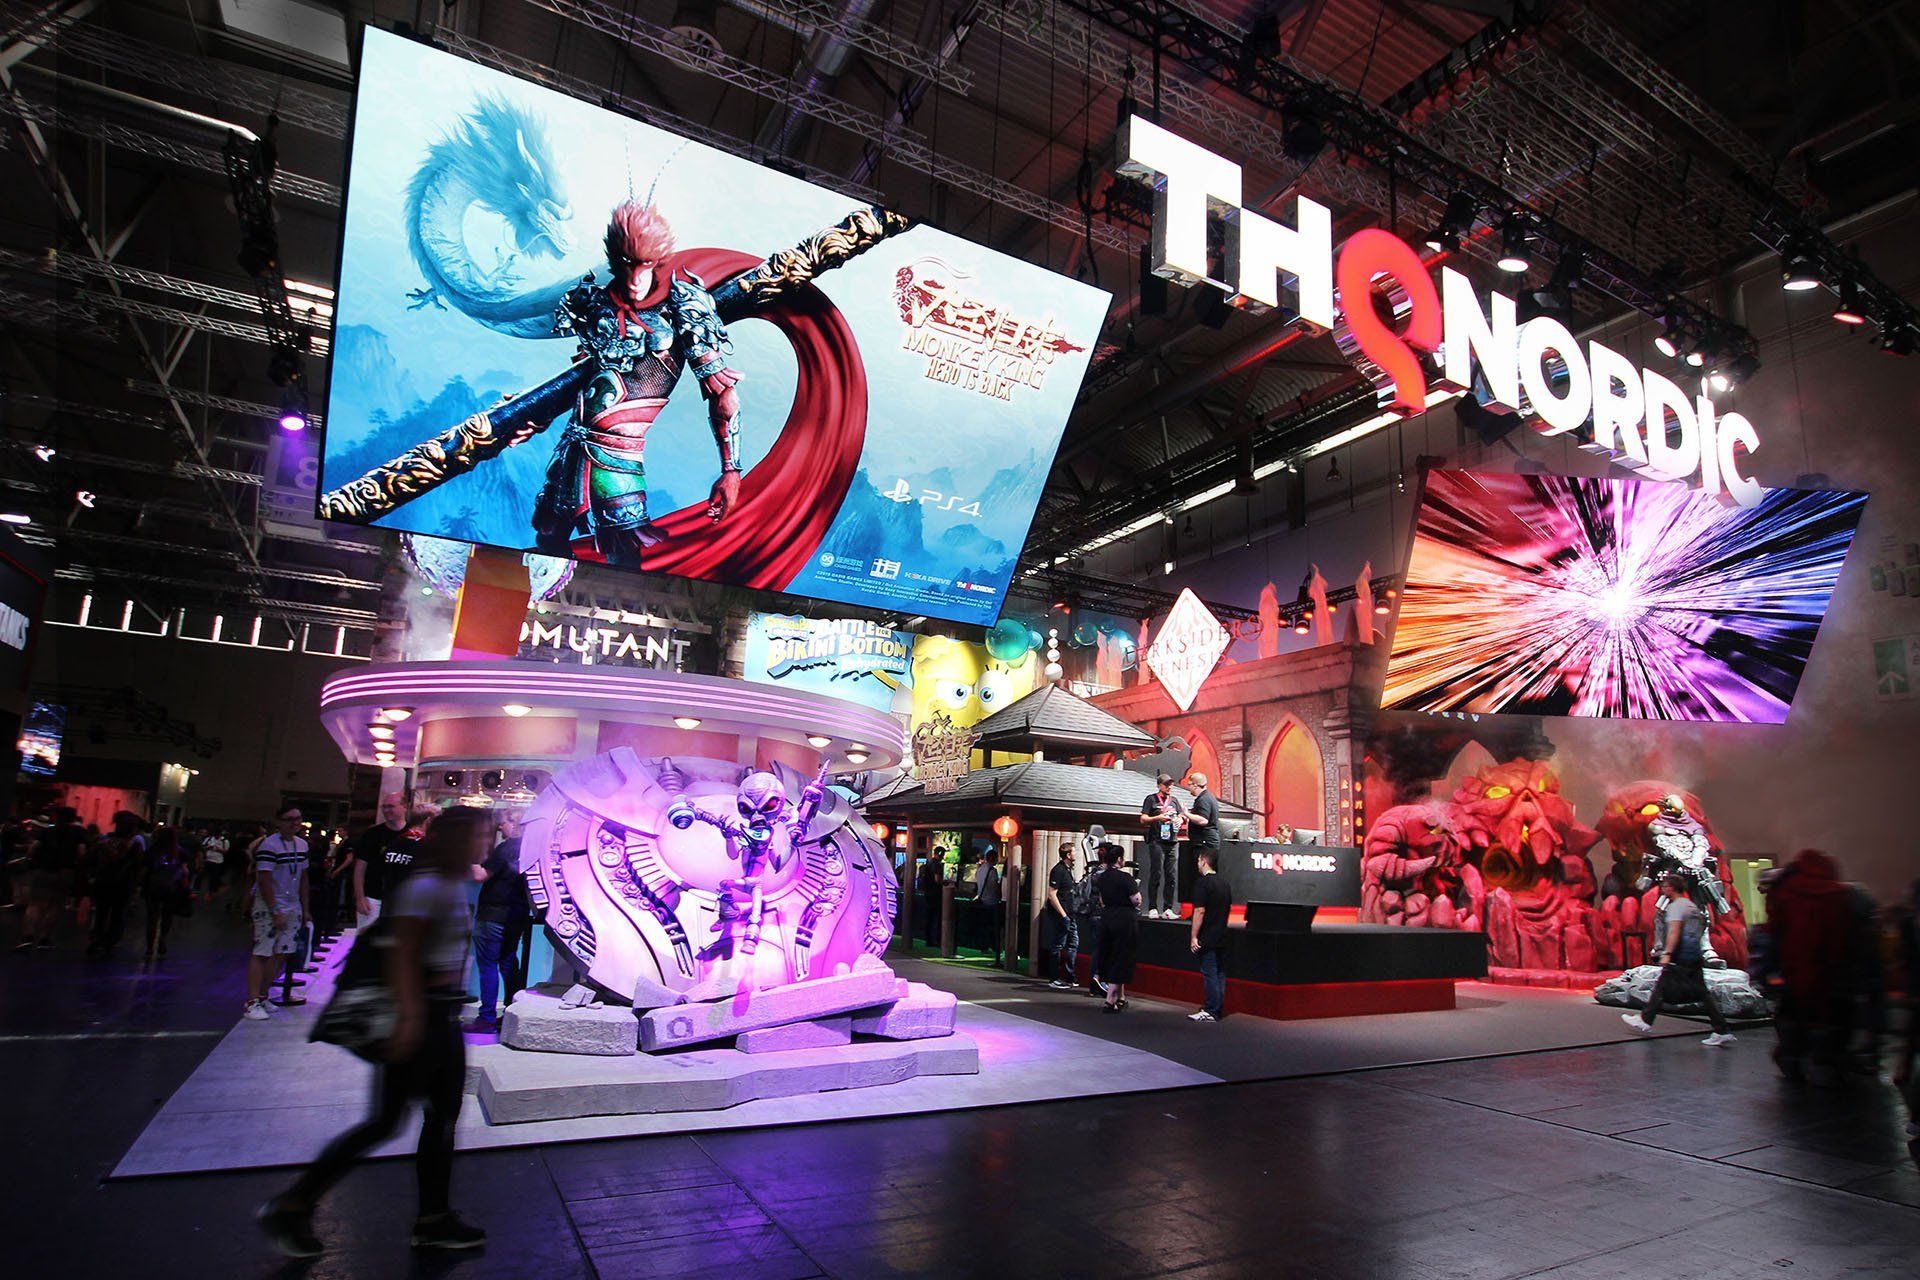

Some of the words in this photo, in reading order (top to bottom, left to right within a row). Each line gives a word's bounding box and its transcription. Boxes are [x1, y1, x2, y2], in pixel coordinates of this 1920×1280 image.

[903, 331, 996, 374] MONKEY
[996, 352, 1046, 390] KING
[925, 359, 961, 385] HERO
[963, 371, 978, 390] IS
[979, 376, 1015, 401] BACK
[919, 488, 982, 517] PS4
[816, 618, 875, 638] BATTLE
[768, 636, 836, 669] BIKINI
[838, 634, 908, 659] BOTTOM
[385, 851, 413, 865] STAFF
